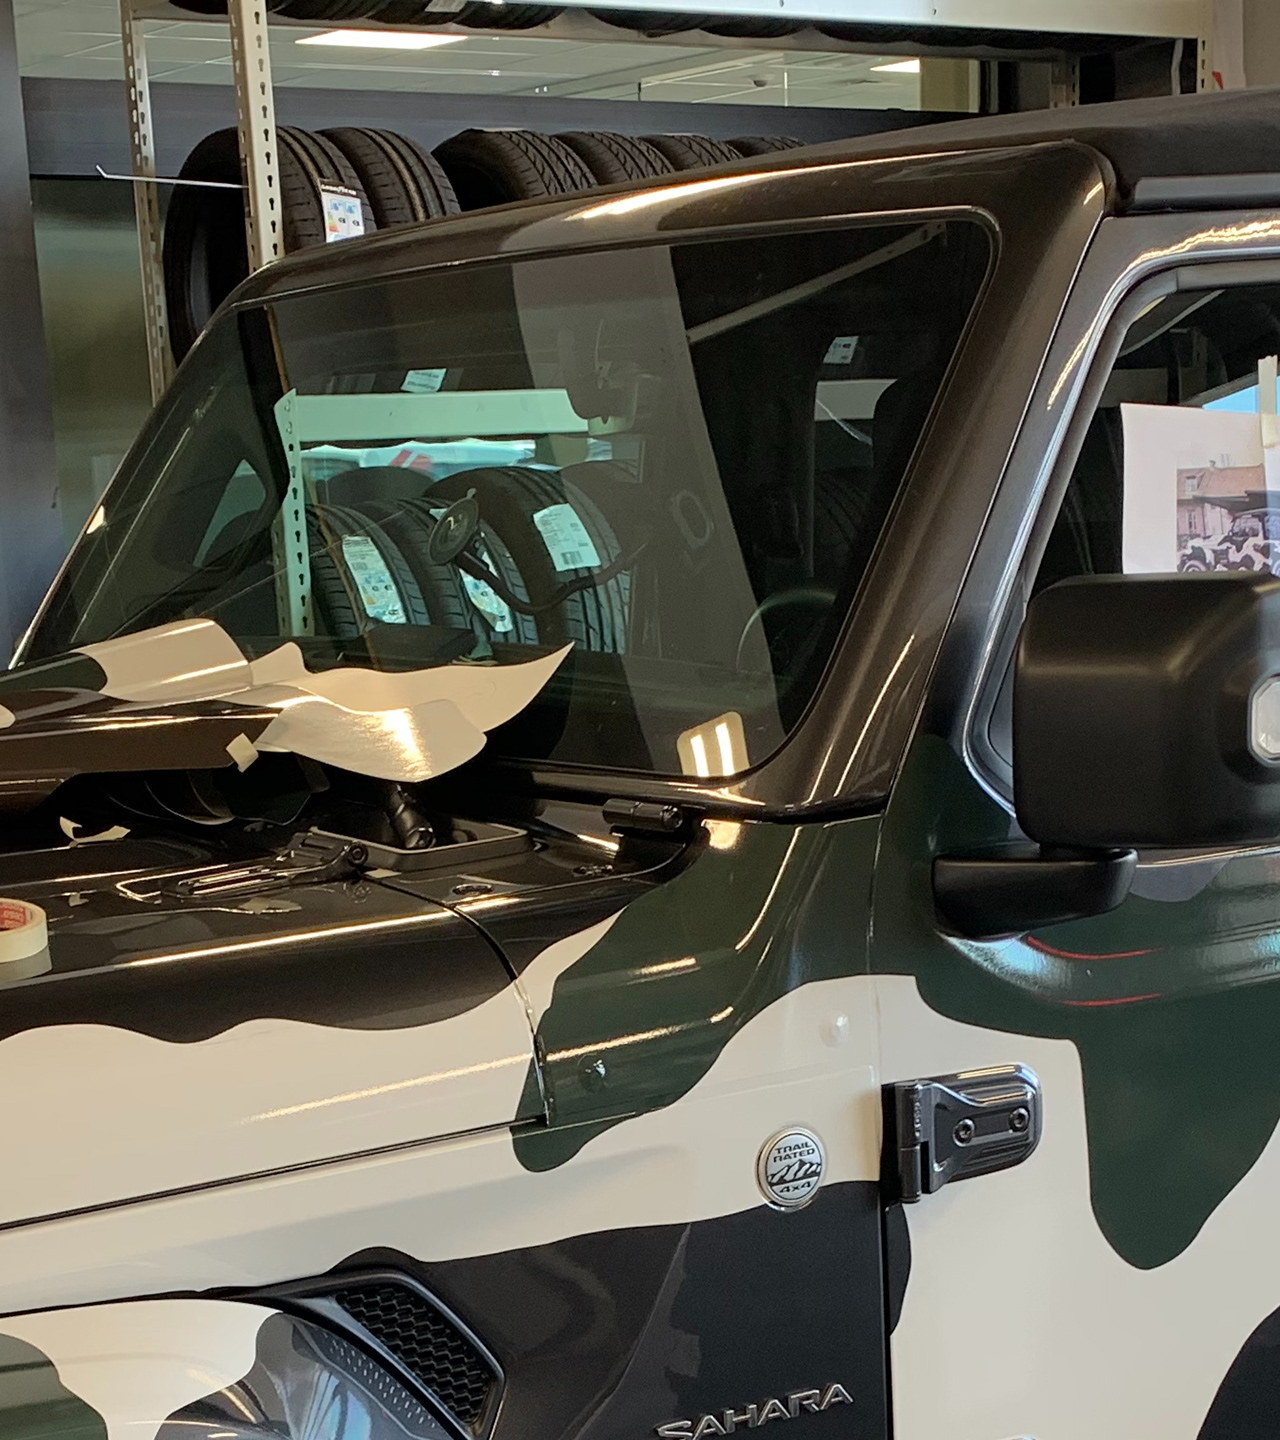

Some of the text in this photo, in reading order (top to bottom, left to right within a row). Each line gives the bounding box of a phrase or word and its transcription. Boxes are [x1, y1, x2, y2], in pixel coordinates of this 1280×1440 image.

[775, 1141, 812, 1155] TRAIL
[773, 1148, 816, 1163] RATED
[779, 1181, 812, 1193] 4x4
